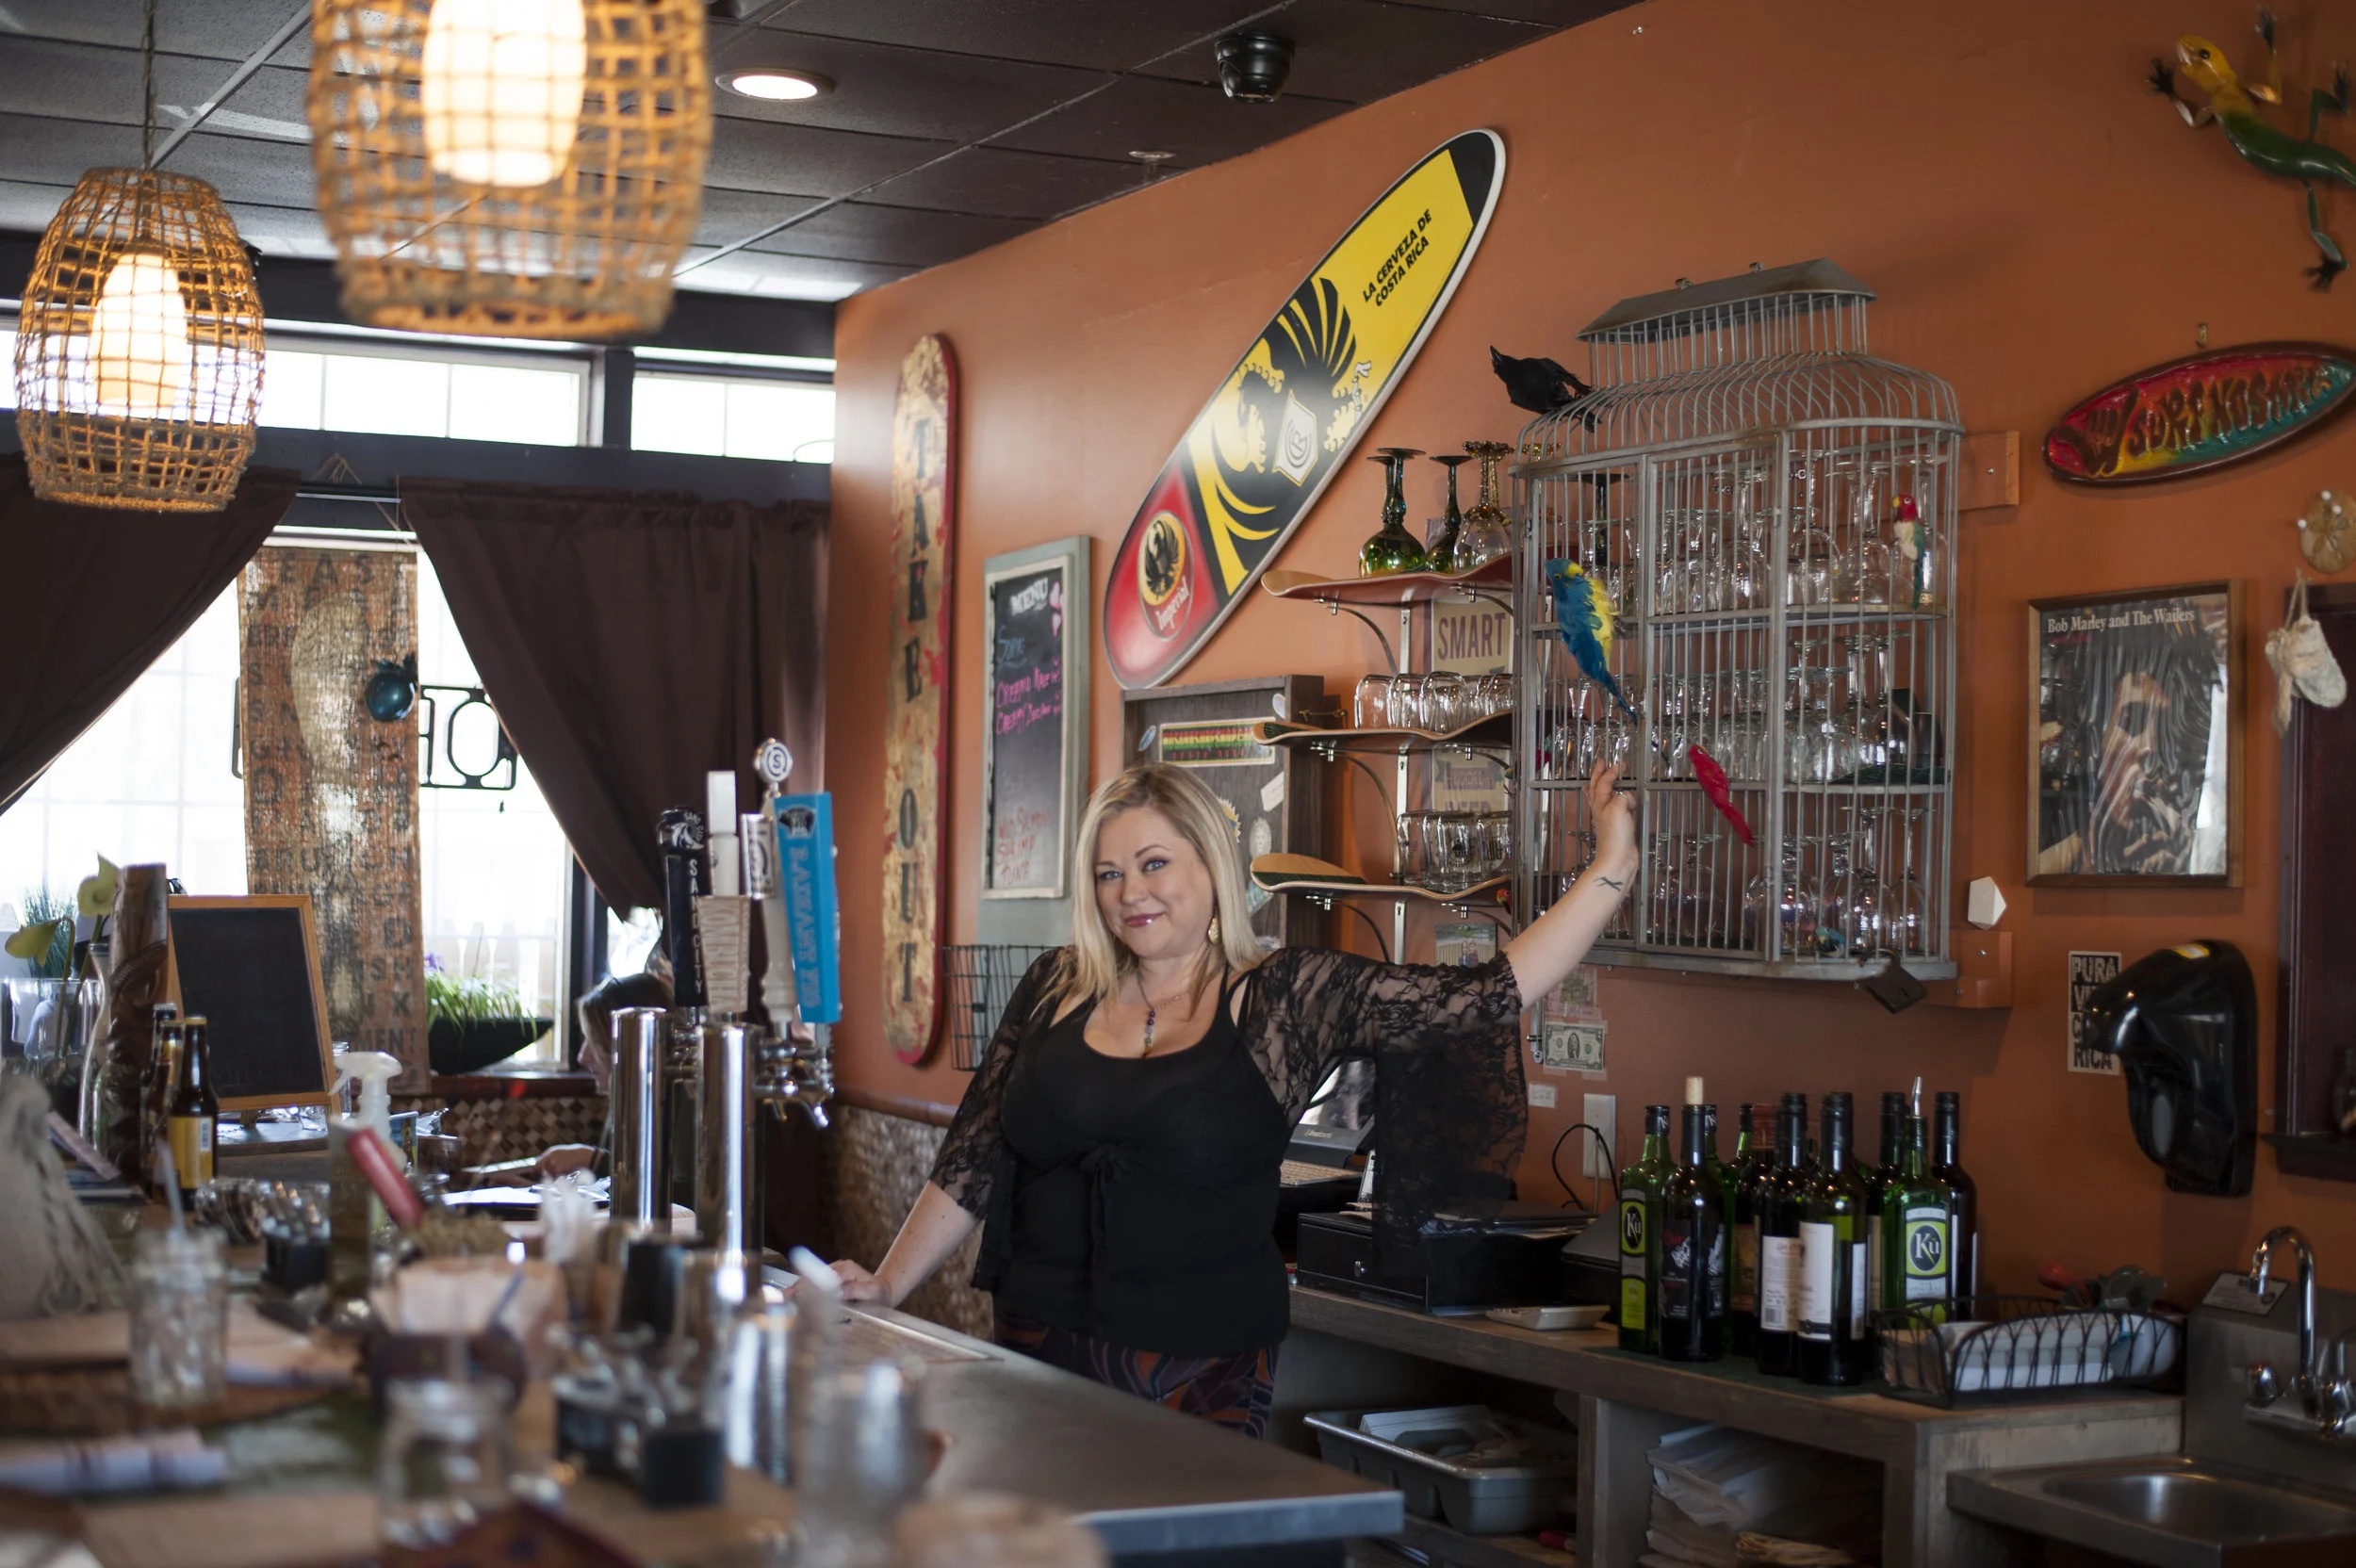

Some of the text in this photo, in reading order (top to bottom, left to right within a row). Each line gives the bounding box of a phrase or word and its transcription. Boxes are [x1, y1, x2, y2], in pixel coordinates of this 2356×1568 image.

[1363, 208, 1432, 303] LA CERVEZA DE
[1376, 235, 1430, 307] COSTA RICA
[1010, 577, 1049, 616] MENU
[1154, 575, 1190, 631] Imperial
[2047, 608, 2195, 633] Bob Marley and The Wailers
[1437, 612, 1506, 661] SMART
[898, 788, 919, 1003] OUT
[693, 934, 702, 994] CITY
[2071, 956, 2117, 983] PURA
